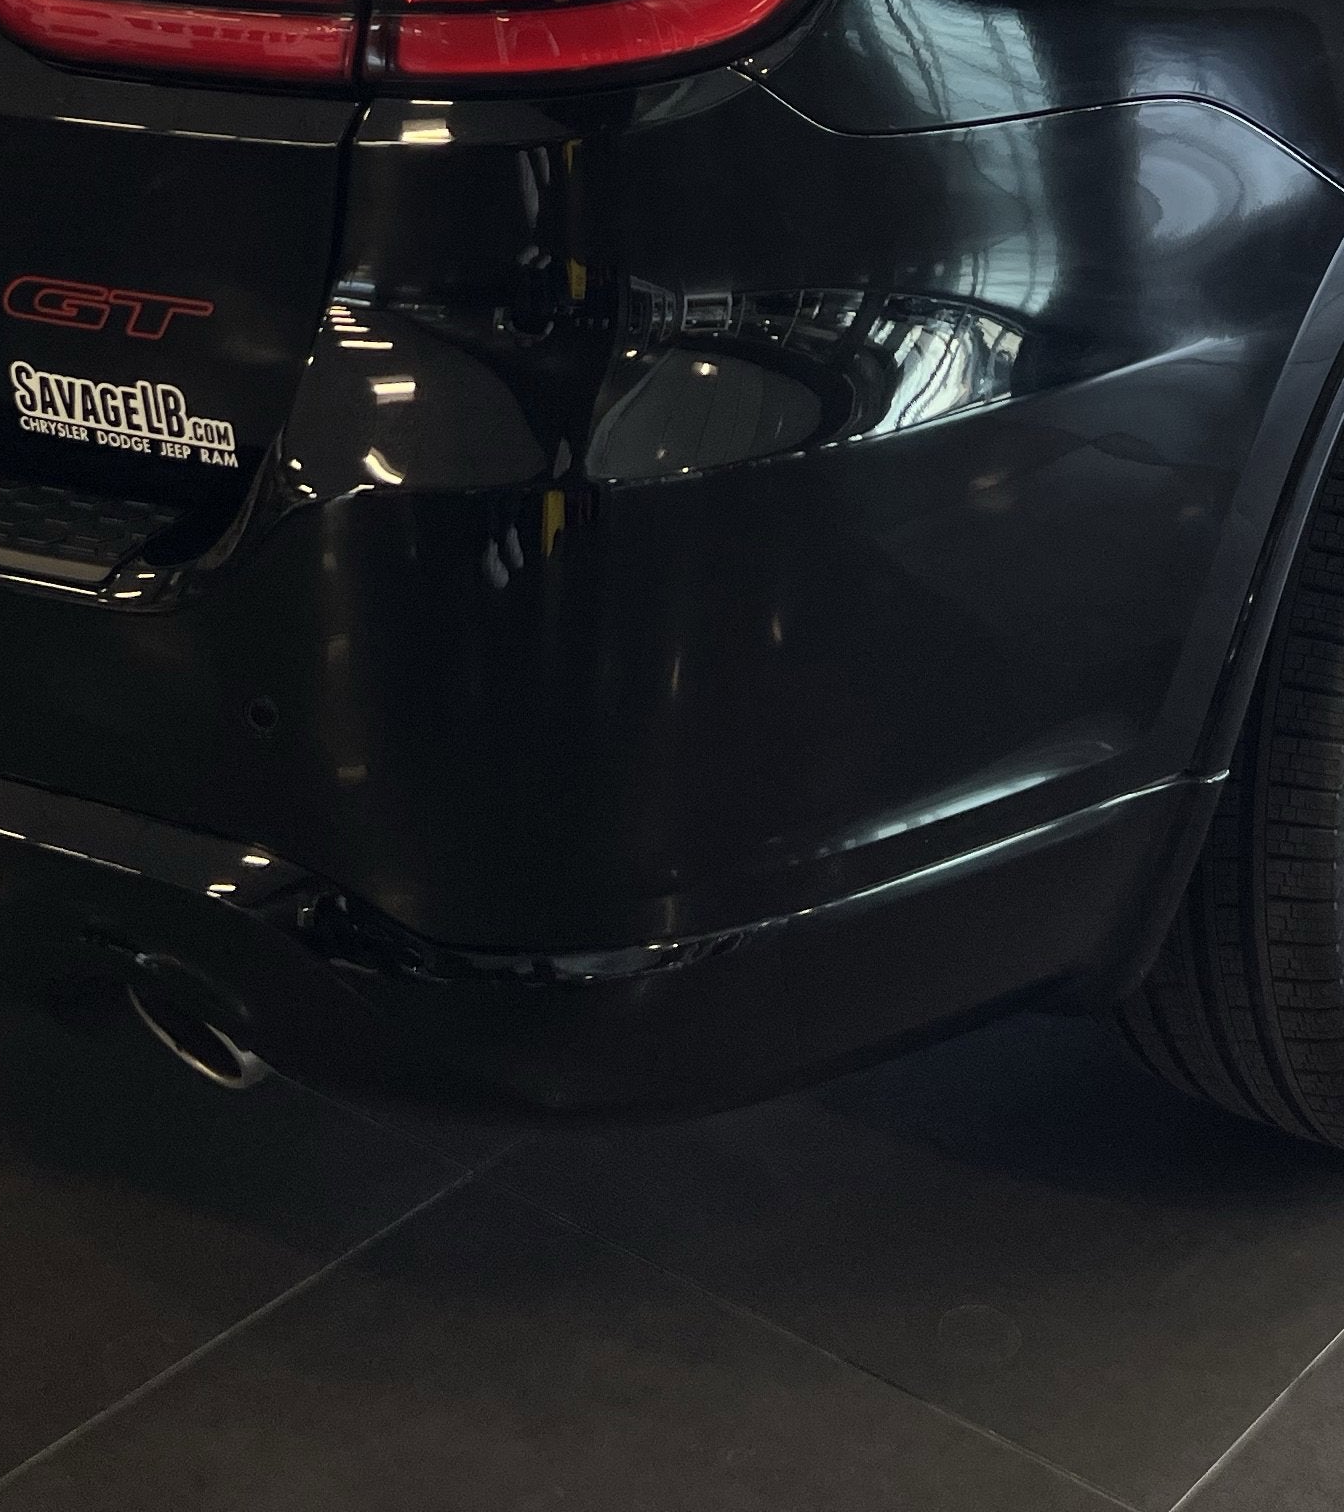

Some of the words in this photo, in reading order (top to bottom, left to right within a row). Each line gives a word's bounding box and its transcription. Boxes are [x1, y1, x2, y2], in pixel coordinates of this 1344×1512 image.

[3, 274, 214, 339] GT
[19, 415, 89, 442] CHRYSLER
[96, 430, 151, 453] DODGE
[160, 441, 191, 460] JEEP
[200, 448, 239, 468] RAM
